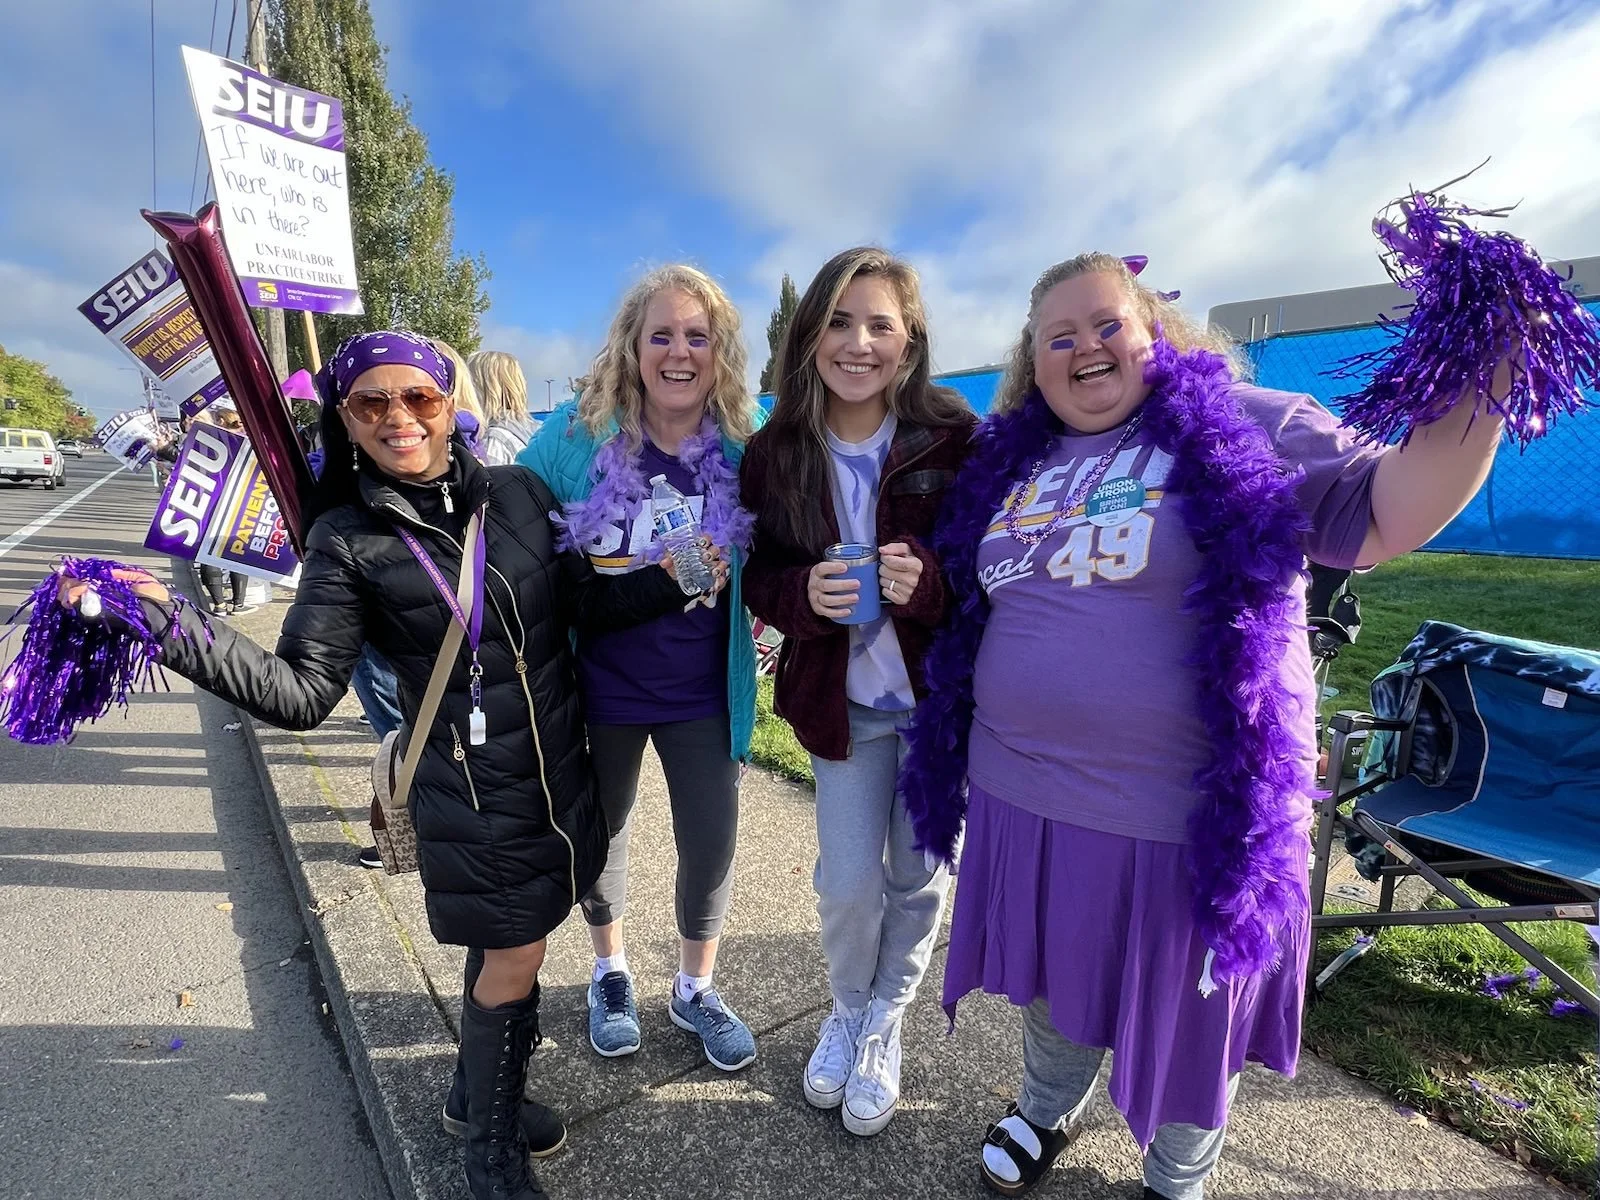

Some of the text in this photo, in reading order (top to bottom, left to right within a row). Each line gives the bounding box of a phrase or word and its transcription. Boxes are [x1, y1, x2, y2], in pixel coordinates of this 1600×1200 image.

[213, 65, 331, 138] SEIU
[211, 124, 343, 189] If we are out
[220, 163, 329, 213] here, who is
[231, 201, 311, 238] in there?
[247, 260, 345, 285] PRACTICE STRIKE
[255, 242, 334, 267] UNFAIR LABOR
[92, 255, 168, 326] SEIU
[132, 308, 197, 360] PROTECT US, RESPECT
[152, 342, 176, 365] STAFF
[170, 336, 189, 352] US,
[179, 325, 199, 344] PAY
[98, 412, 128, 444] SEIU
[159, 429, 229, 547] SEIU
[1092, 483, 1138, 501] STRONG
[1097, 478, 1134, 492] UNION
[1099, 496, 1128, 508] BRING
[230, 470, 270, 556] PATIENT
[250, 489, 279, 553] BEFO
[1109, 502, 1128, 511] ON!
[263, 513, 288, 560] PRO
[1045, 513, 1155, 587] 49
[977, 541, 1042, 590] ocal
